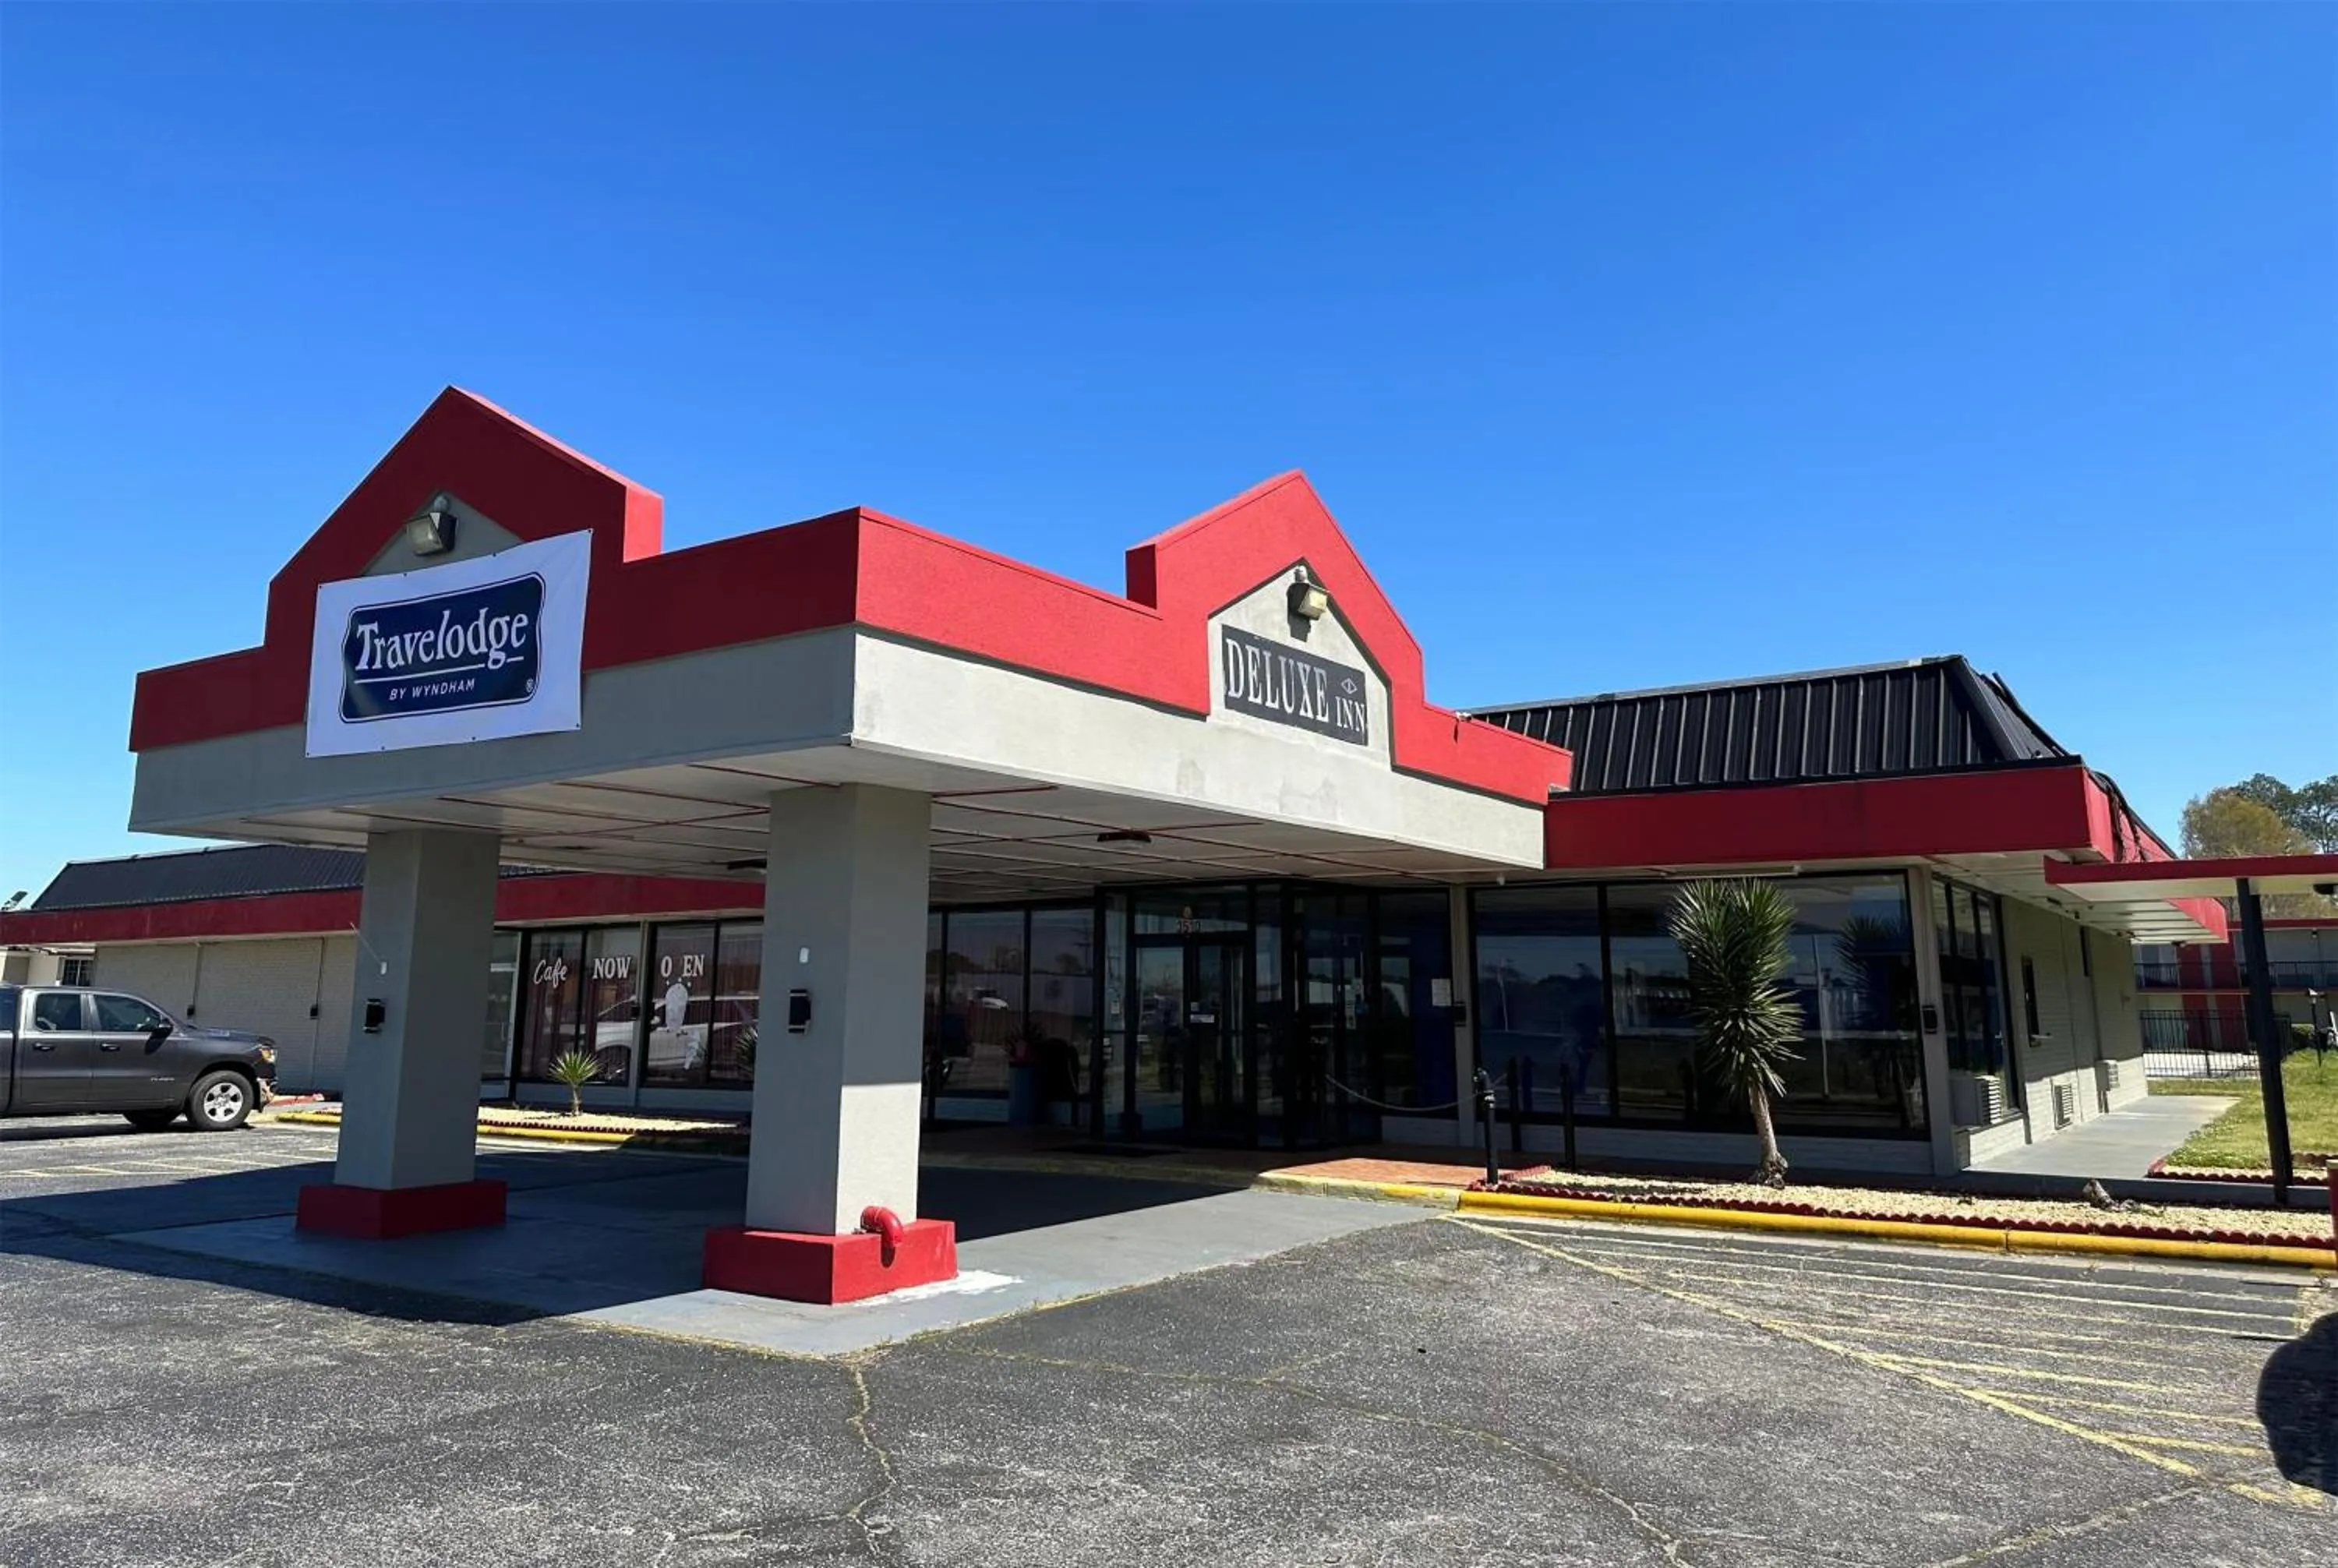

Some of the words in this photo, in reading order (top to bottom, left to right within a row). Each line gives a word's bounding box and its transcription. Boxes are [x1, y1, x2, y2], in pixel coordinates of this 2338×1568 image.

[355, 608, 528, 669] Travelodge
[390, 687, 406, 701] BY
[411, 679, 475, 698] WYNDHAM
[1226, 638, 1330, 722] DELUXE
[1335, 696, 1365, 732] INN
[534, 958, 567, 987] Cafe
[593, 957, 631, 979] NOW
[662, 955, 705, 978] OEN
